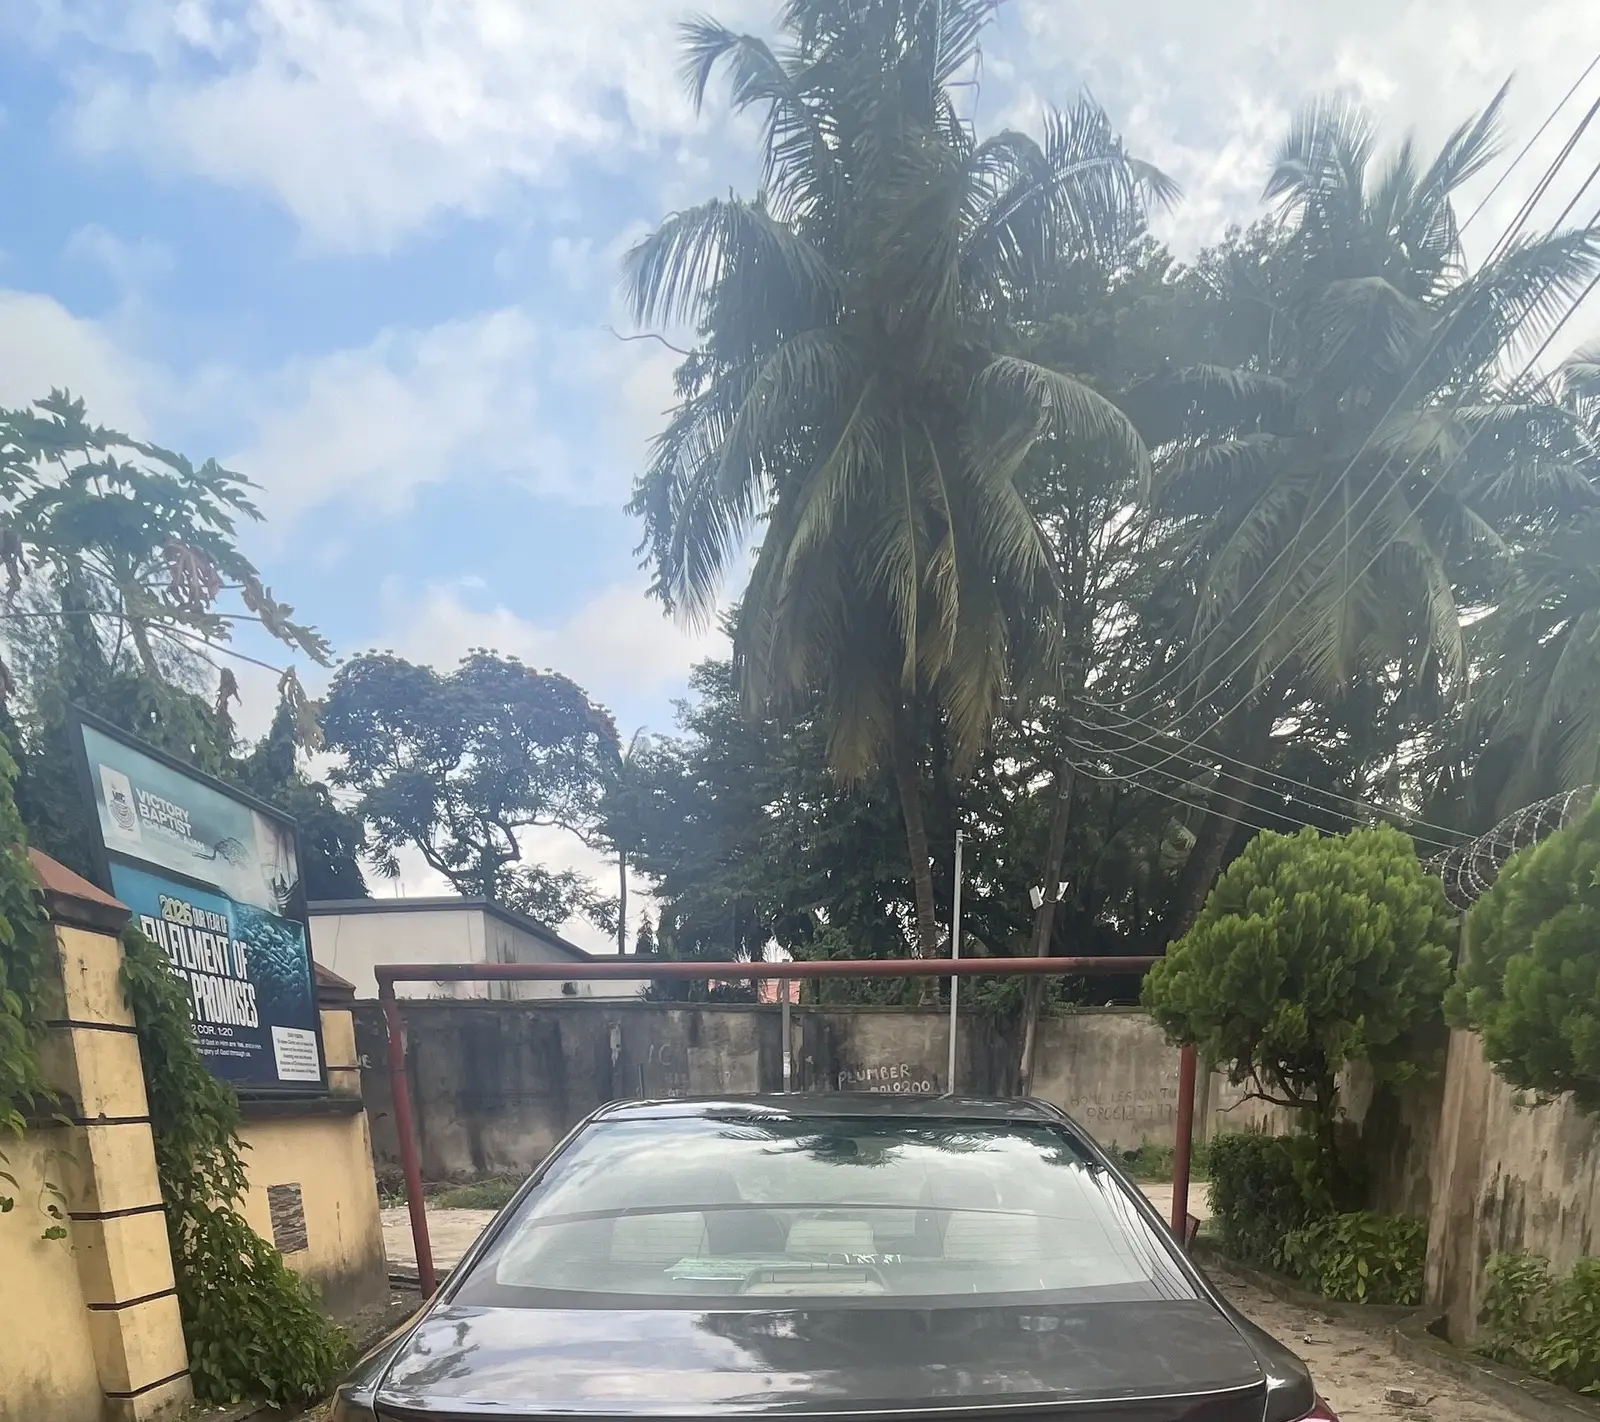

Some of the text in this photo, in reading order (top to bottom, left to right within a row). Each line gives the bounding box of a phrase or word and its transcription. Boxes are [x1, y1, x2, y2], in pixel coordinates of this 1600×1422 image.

[136, 788, 189, 822] VICTORY
[139, 803, 192, 836] BAPTIST
[205, 911, 222, 932] YEAR
[232, 940, 248, 980] OF
[190, 972, 259, 1029] PROMISES
[838, 1063, 911, 1092] PLUMBER
